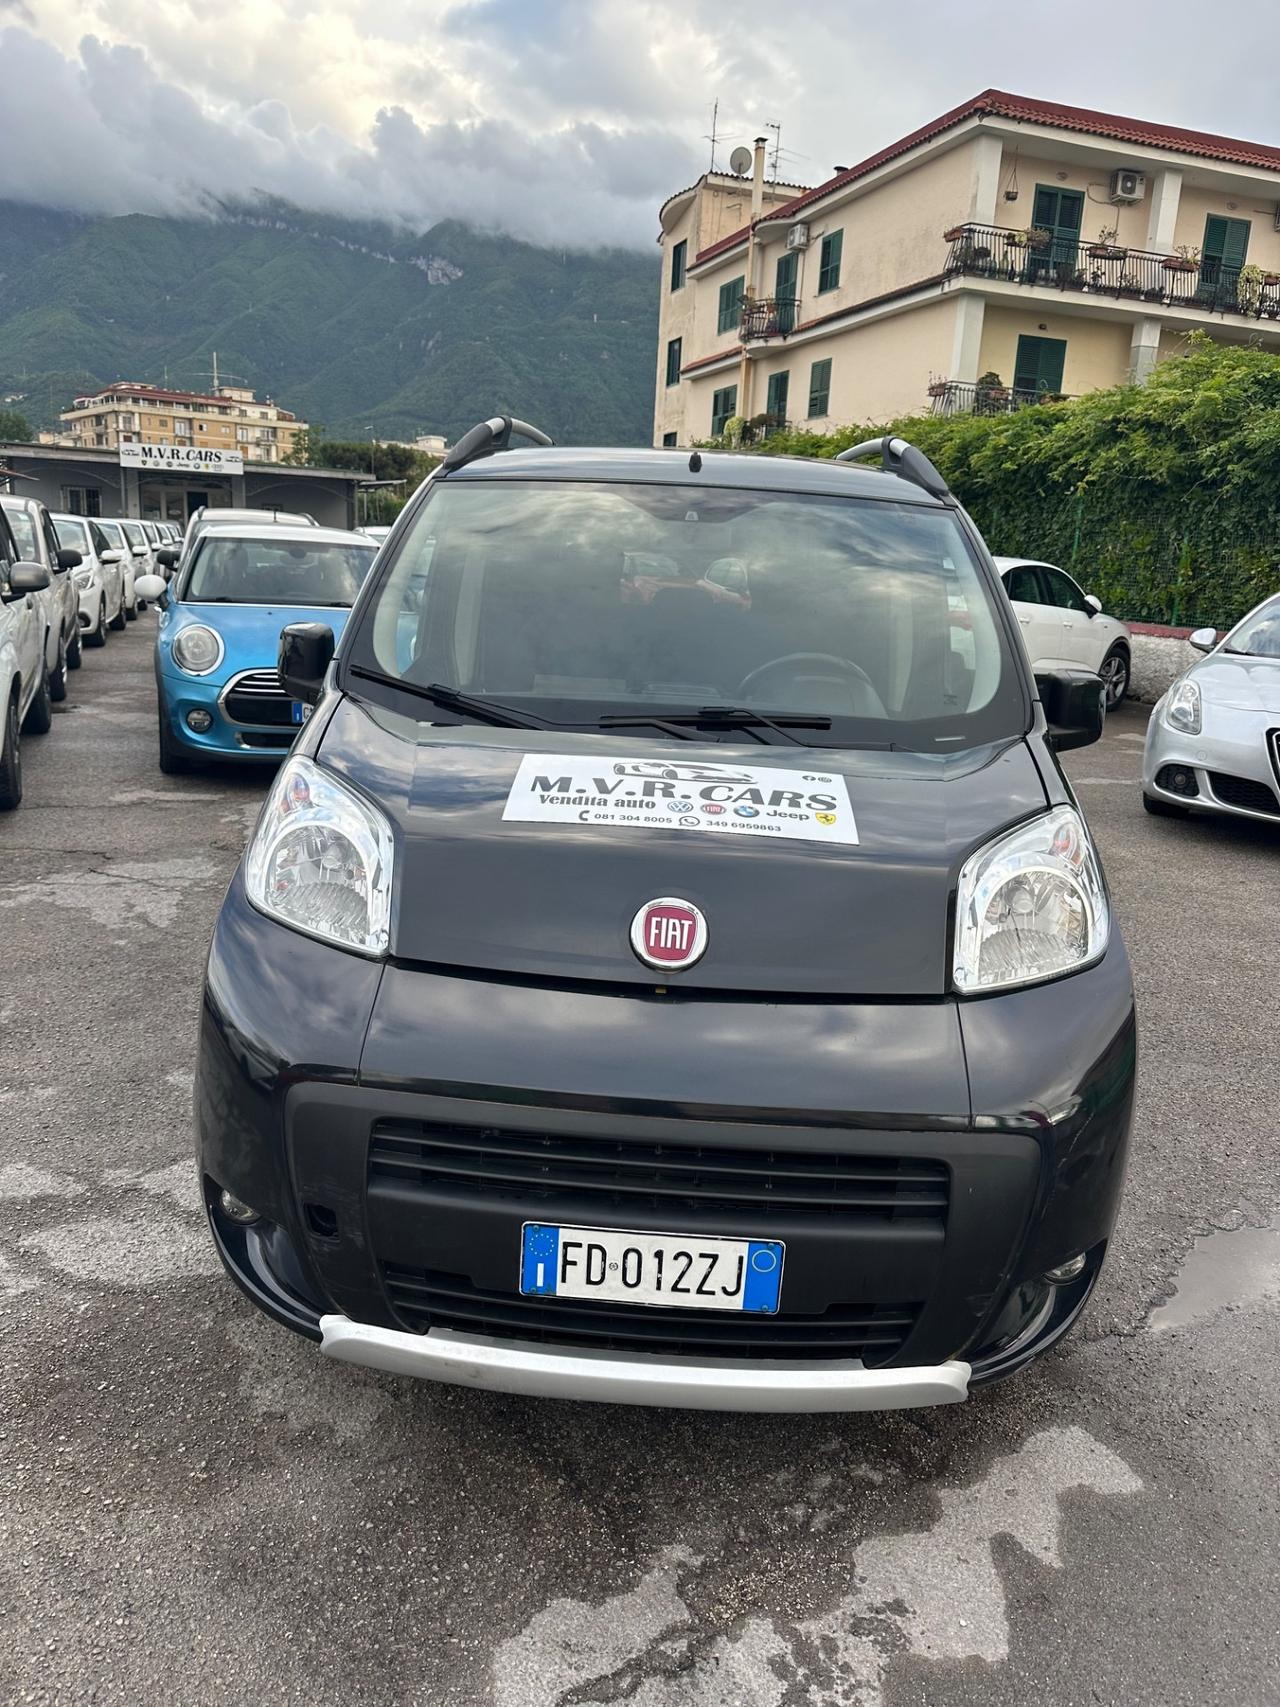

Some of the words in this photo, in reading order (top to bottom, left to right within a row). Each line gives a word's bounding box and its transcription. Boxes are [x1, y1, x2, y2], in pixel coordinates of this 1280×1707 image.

[539, 794, 608, 807] Vendita
[614, 799, 656, 809] auto
[766, 809, 810, 821] Jeep
[649, 916, 693, 950] FIAT
